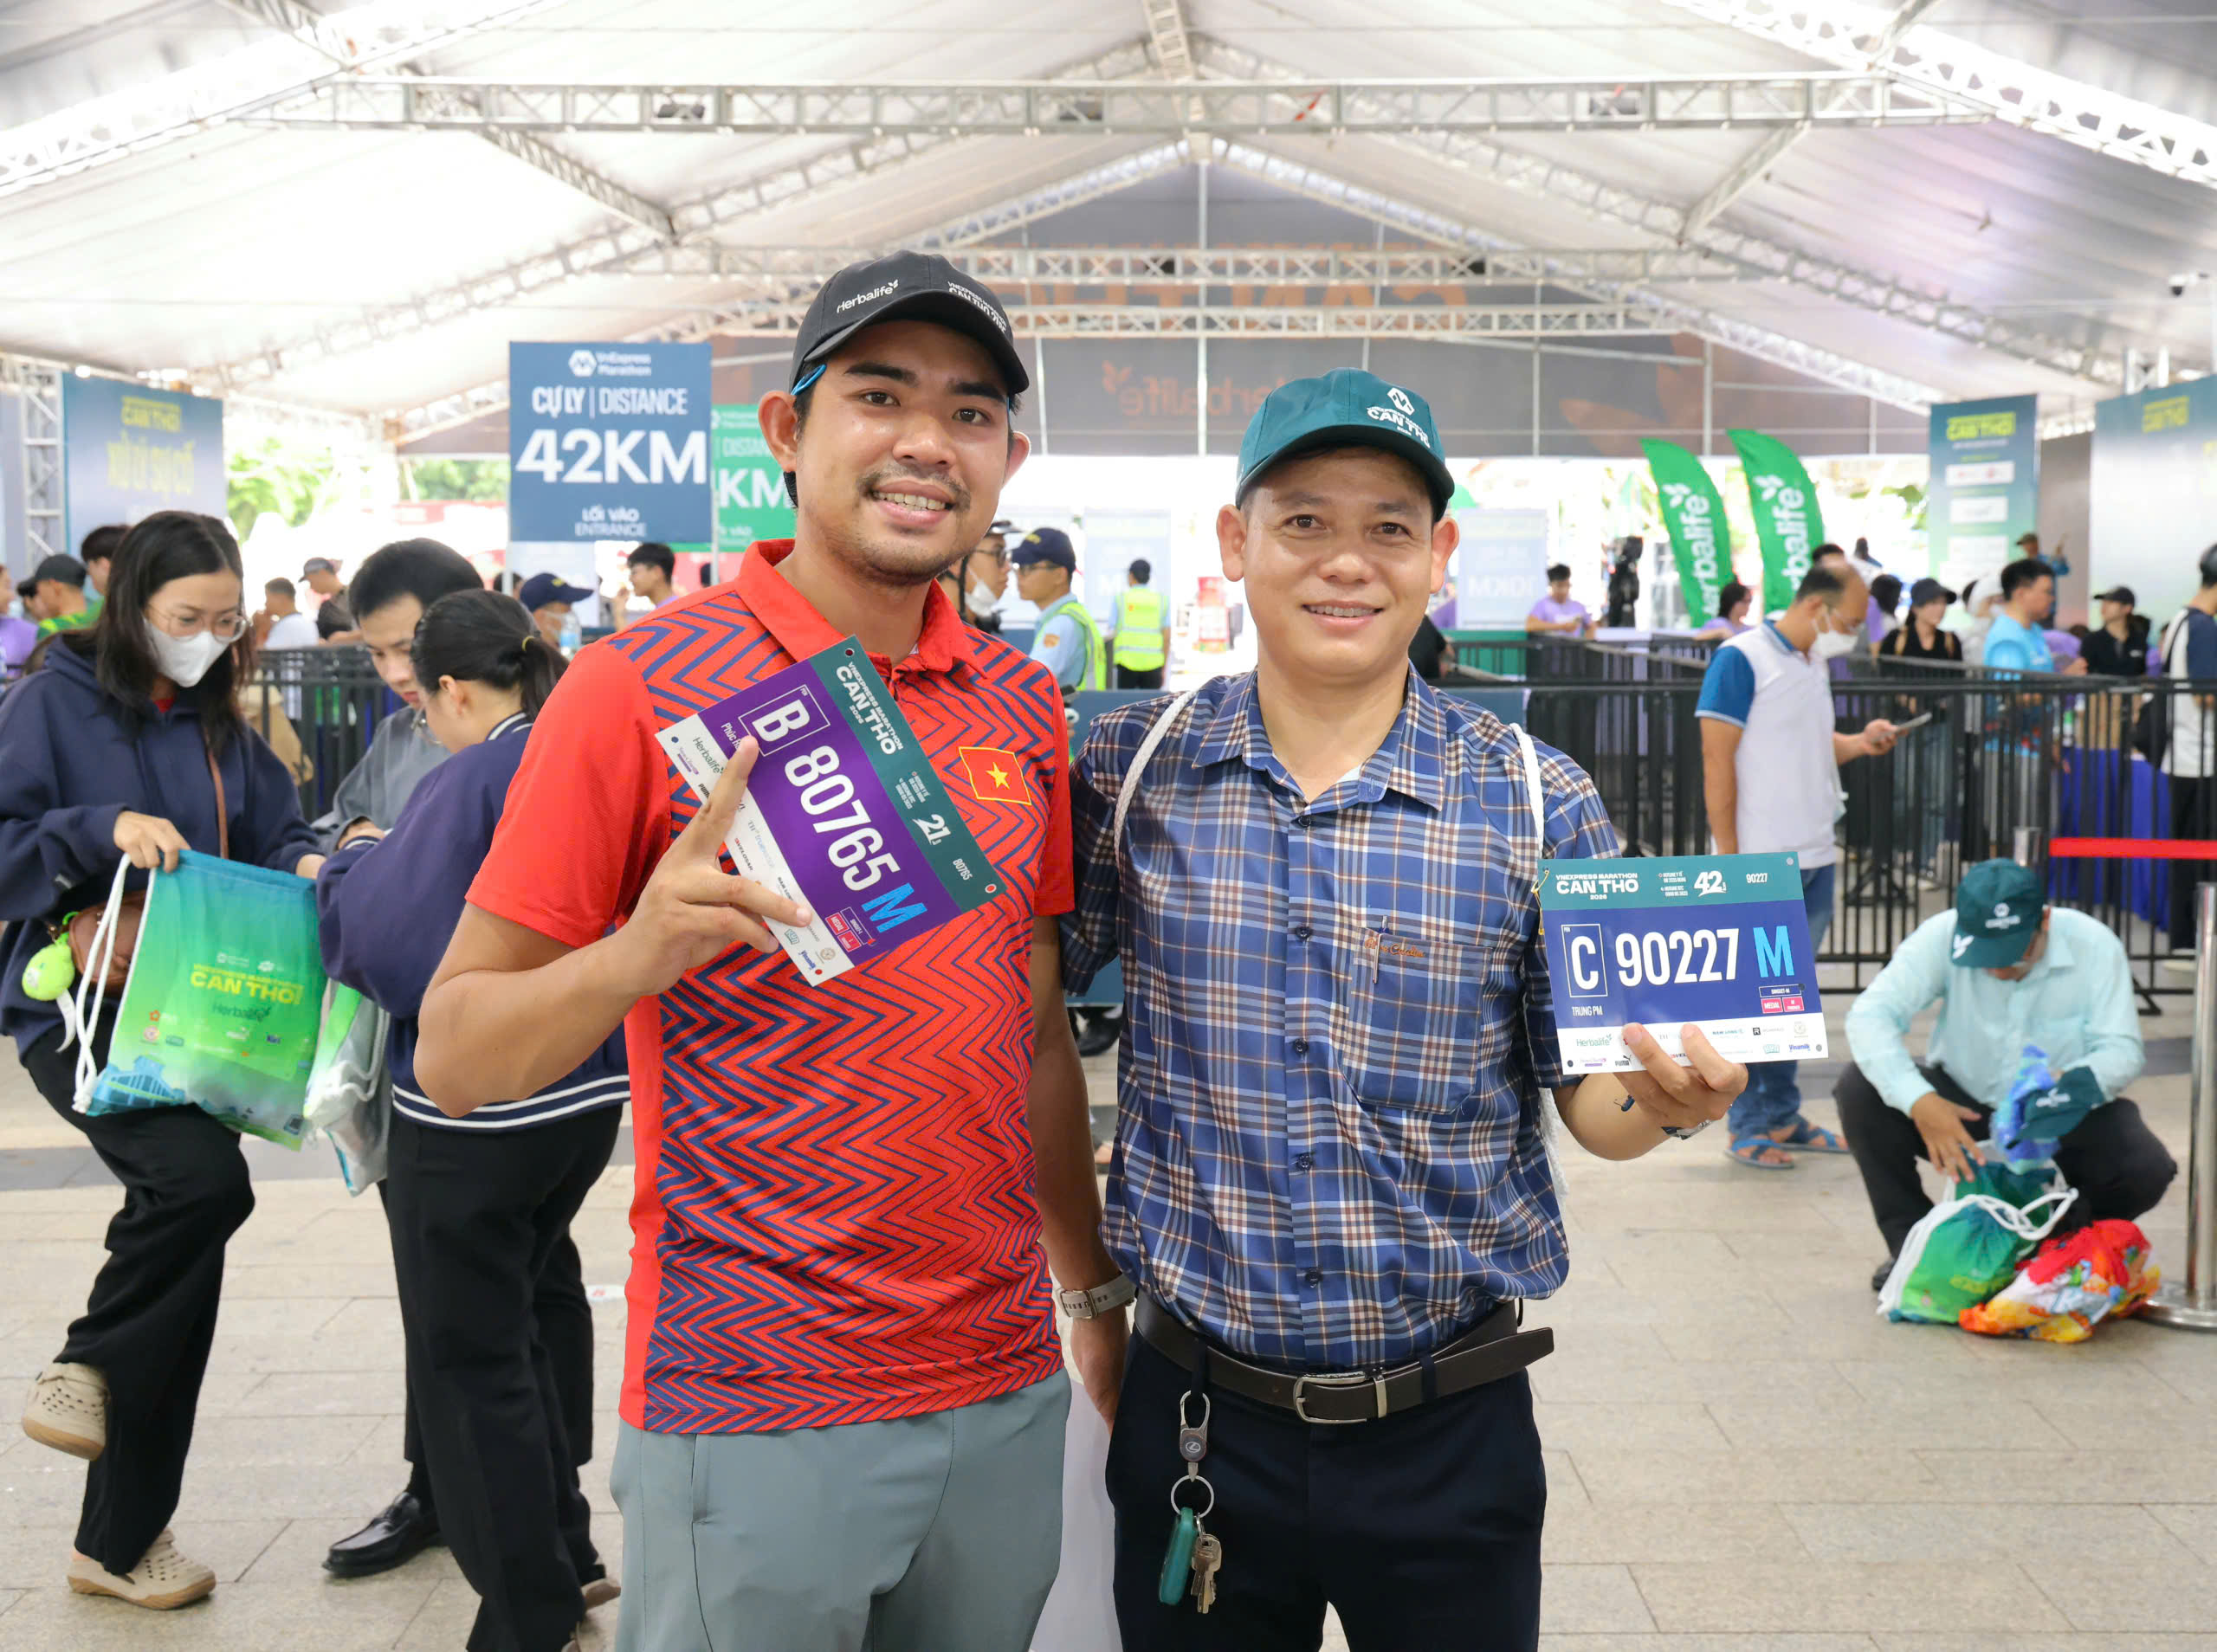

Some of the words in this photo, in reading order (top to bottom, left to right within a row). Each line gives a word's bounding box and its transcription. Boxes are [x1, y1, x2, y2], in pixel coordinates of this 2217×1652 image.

[837, 284, 894, 313] Herbalife
[598, 387, 688, 416] DISTANCE
[1367, 409, 1404, 427] CAN
[515, 428, 707, 484] 42KM
[719, 468, 794, 508] KM
[574, 521, 646, 537] ENTRANCE
[752, 699, 811, 742] B
[836, 665, 869, 712] CAN
[863, 705, 897, 756] THO
[847, 661, 879, 707] VNEXPRESS
[874, 705, 904, 751] MARATHON
[848, 705, 864, 725] 2026
[691, 736, 722, 775] Herbalife
[783, 745, 902, 892] 80765
[912, 813, 952, 846] 21
[952, 857, 973, 881] 80765
[1693, 870, 1723, 897] 42
[1746, 873, 1768, 883] 90227
[1556, 881, 1596, 894] CAN
[1598, 879, 1639, 893] THO
[861, 881, 928, 933] M
[1571, 935, 1600, 991] C
[1614, 927, 1739, 988] 90227
[1753, 925, 1794, 978] M
[191, 971, 242, 995] CAN
[1572, 1006, 1592, 1016] TRUNG
[1593, 1005, 1603, 1016] PM
